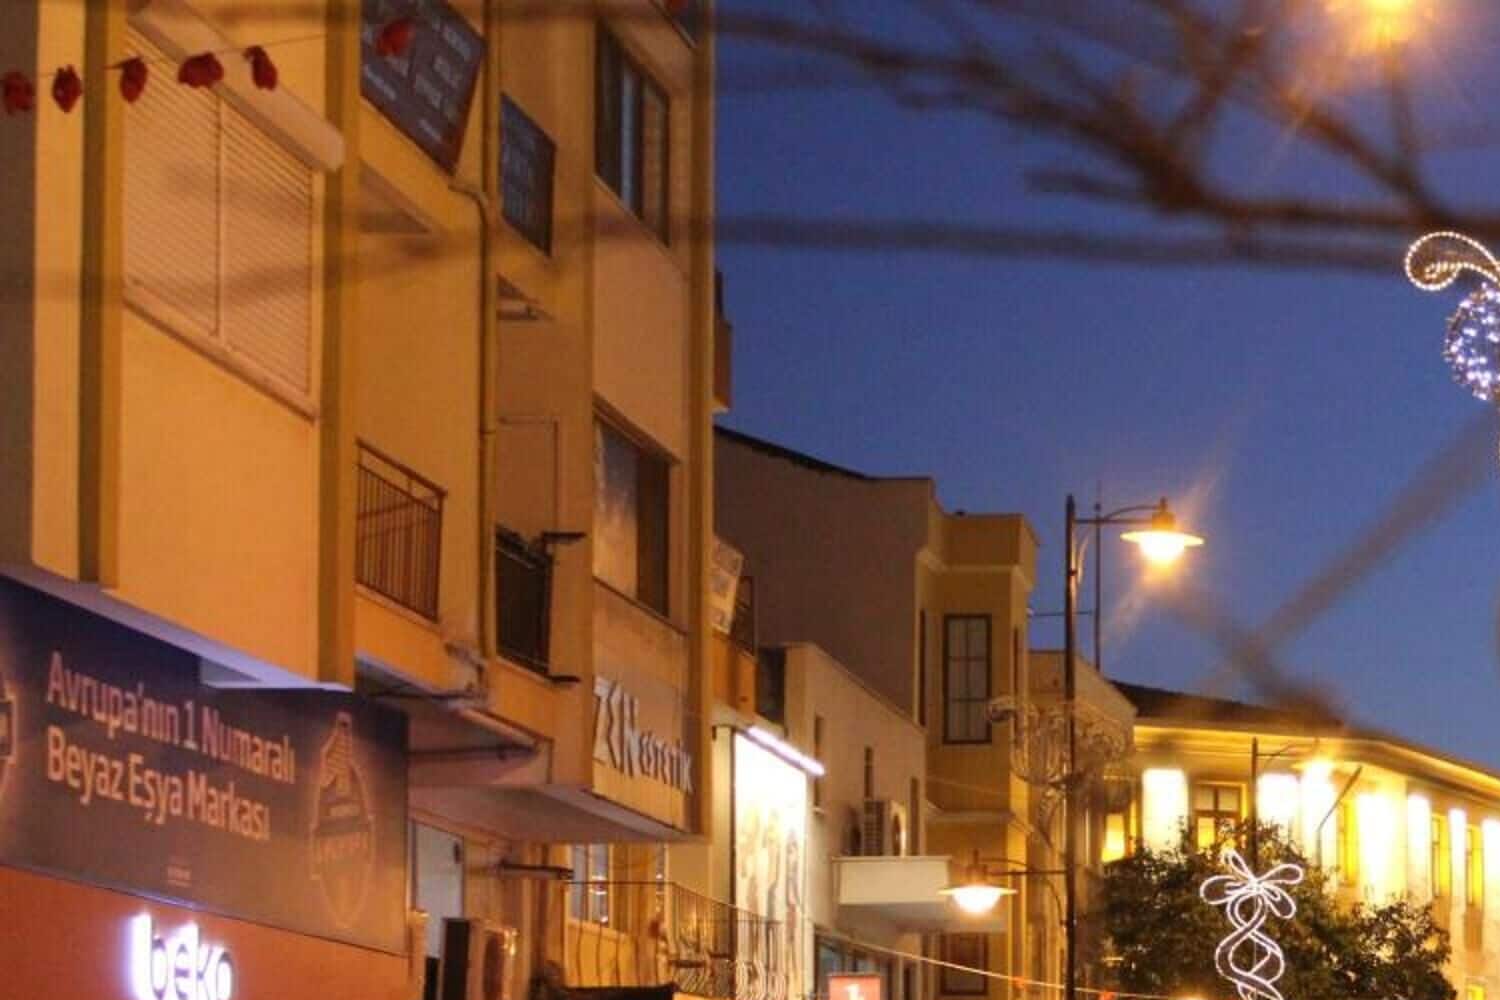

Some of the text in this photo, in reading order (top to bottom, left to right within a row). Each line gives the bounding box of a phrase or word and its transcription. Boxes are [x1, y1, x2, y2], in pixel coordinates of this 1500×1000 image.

[48, 651, 295, 785] Avrupa'nın 1 Numaralı
[48, 725, 270, 841] Beyaz Eşya Markası
